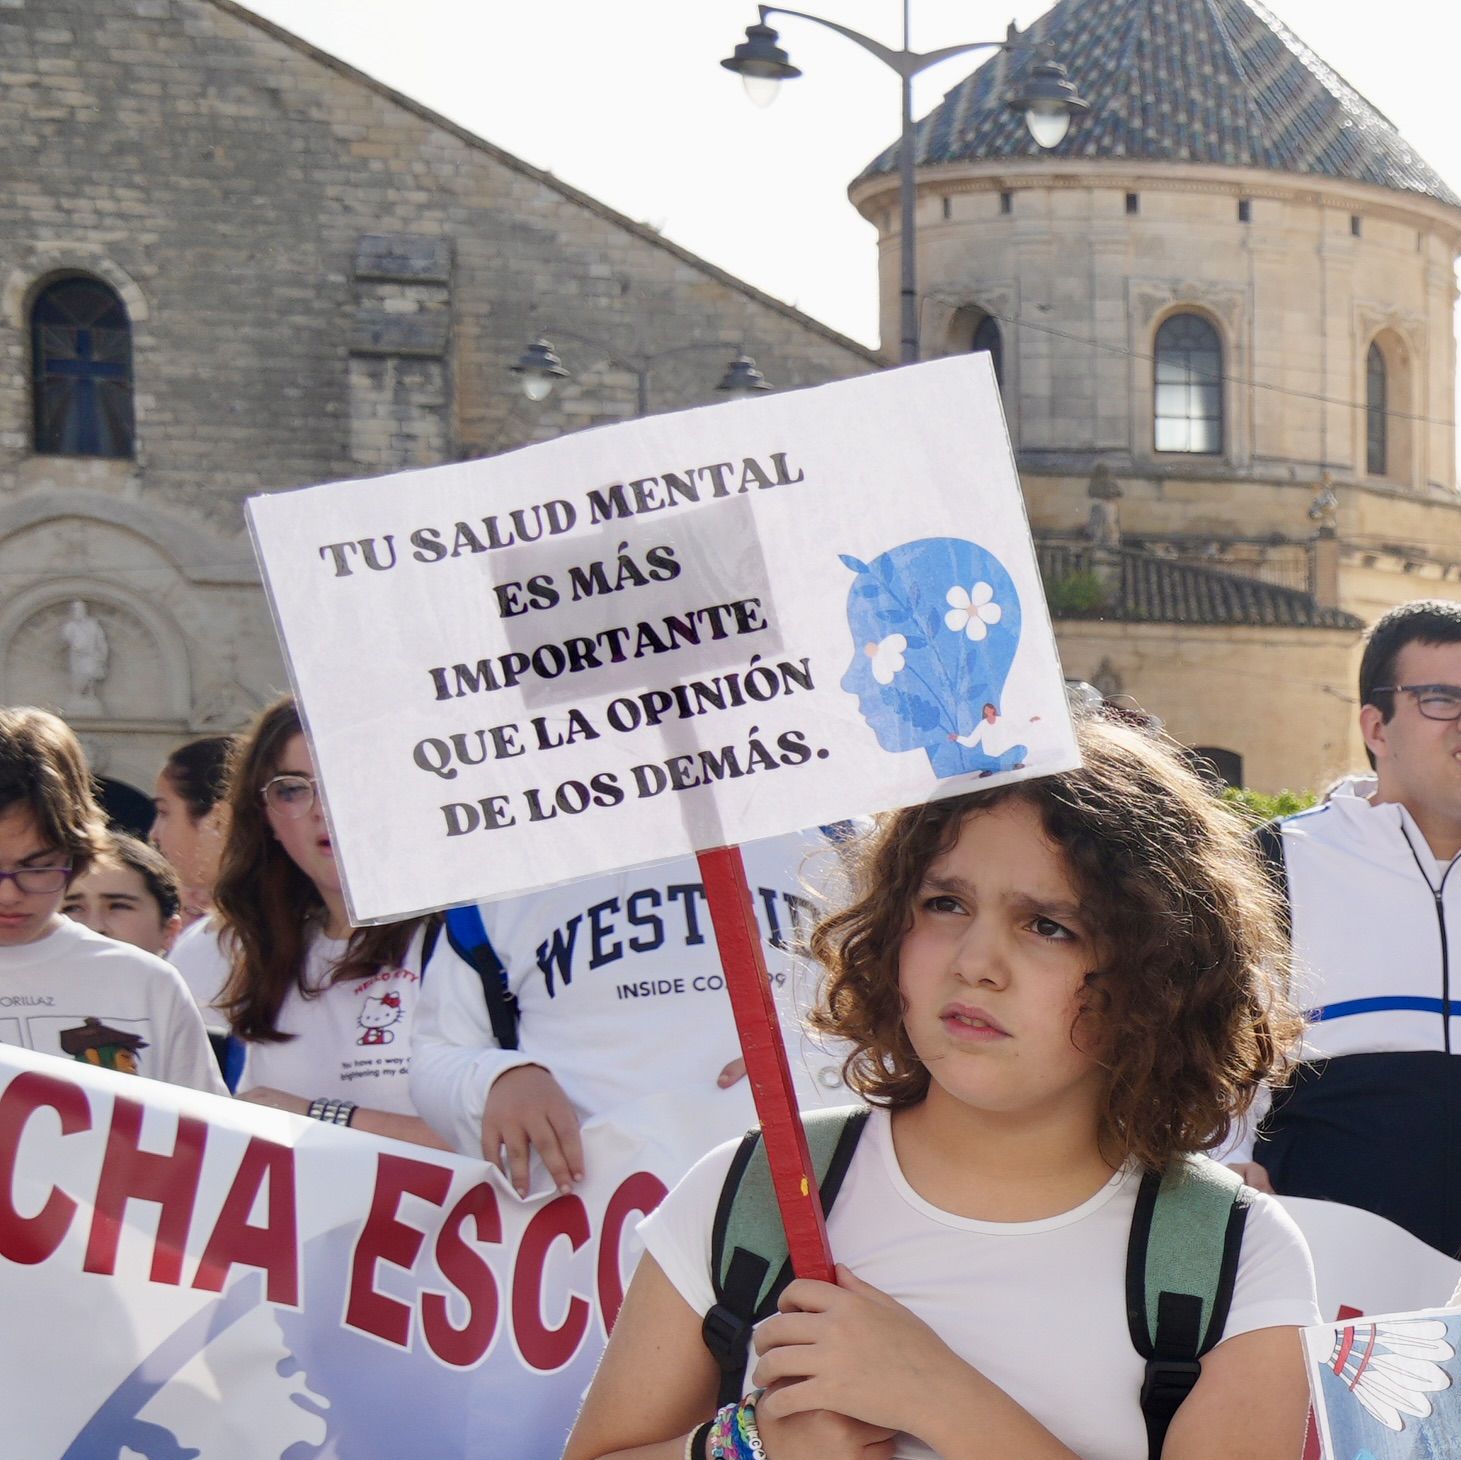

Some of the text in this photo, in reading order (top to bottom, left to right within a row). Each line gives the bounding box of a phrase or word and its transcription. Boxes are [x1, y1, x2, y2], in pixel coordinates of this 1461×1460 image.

[319, 452, 804, 578] TU SALUD MENTAL
[492, 541, 682, 619] ES MÁS
[428, 597, 768, 701] IMPORTANTE
[413, 654, 815, 780] QUE LA OPINIÓN
[439, 726, 830, 837] DE LOS DEMÁS.
[616, 977, 685, 999] INSIDE
